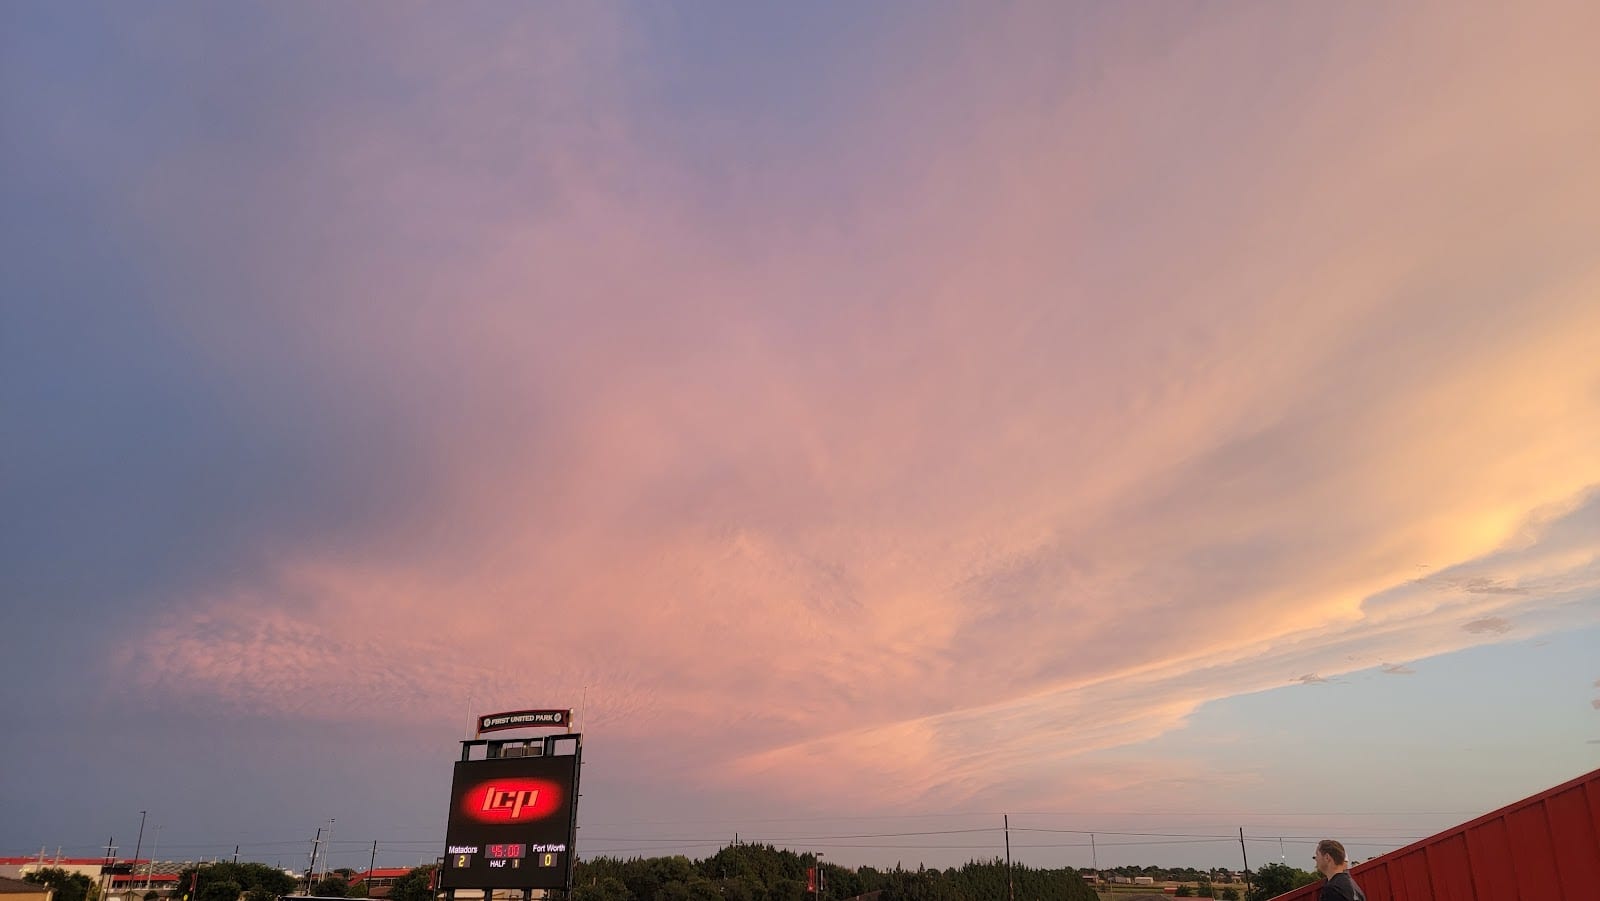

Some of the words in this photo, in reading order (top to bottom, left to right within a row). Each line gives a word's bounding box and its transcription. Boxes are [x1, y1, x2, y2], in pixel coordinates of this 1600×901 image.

[491, 716, 510, 725] FIRST
[448, 845, 478, 854] Matadors
[491, 844, 520, 858] 45:00
[532, 844, 546, 852] Fort
[546, 844, 566, 852] Worth
[458, 855, 466, 868] 2
[490, 860, 506, 868] HALF
[544, 854, 552, 867] 0
